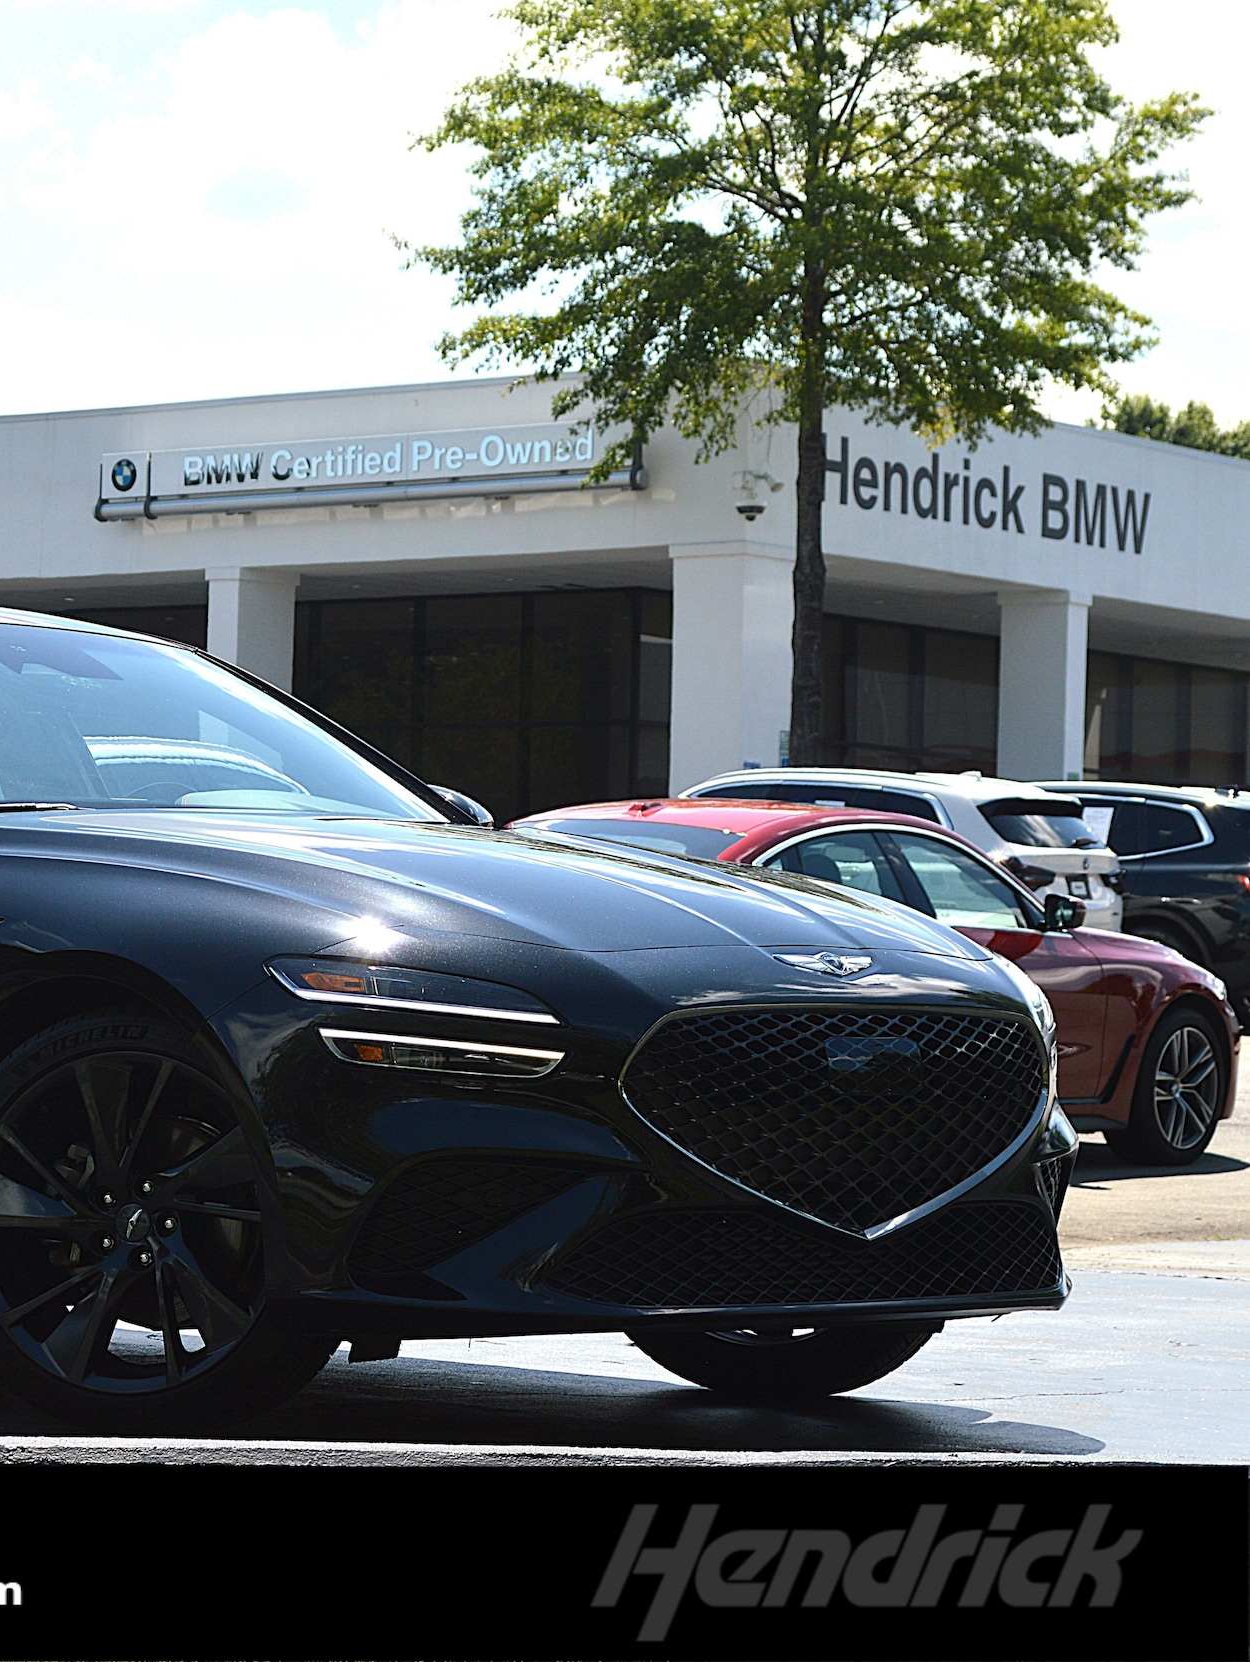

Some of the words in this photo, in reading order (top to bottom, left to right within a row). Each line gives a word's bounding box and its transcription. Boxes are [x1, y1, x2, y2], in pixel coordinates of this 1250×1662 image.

[183, 451, 263, 486] BMW
[271, 441, 403, 482] Certified
[411, 428, 596, 474] Pre-Owned
[823, 432, 1026, 534] Hendrick
[1041, 473, 1151, 555] BMW
[39, 1025, 144, 1061] MICHELIN
